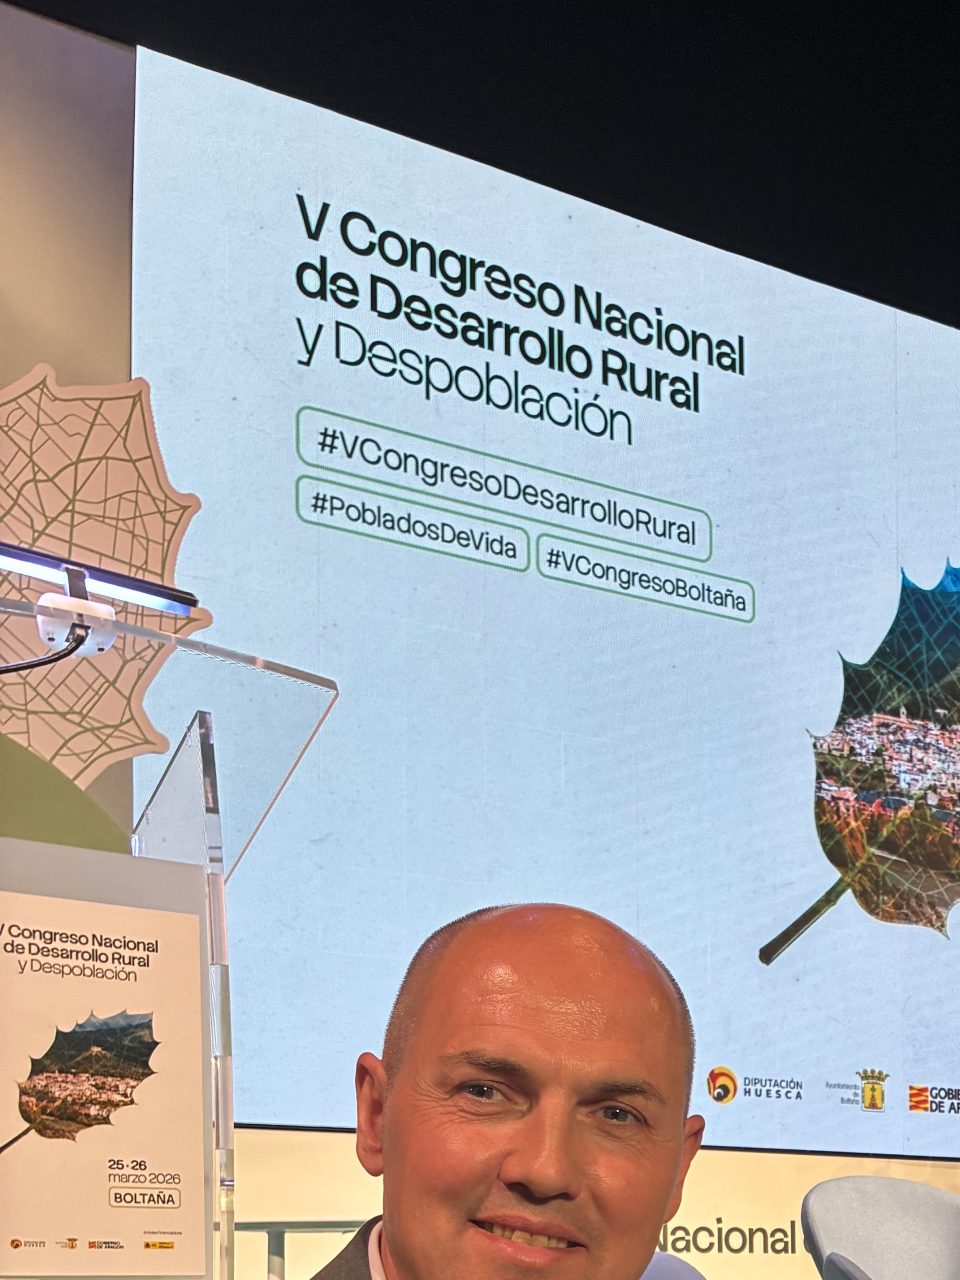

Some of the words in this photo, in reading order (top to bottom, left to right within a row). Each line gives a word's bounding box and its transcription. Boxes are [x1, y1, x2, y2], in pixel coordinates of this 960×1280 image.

[296, 193, 331, 241] V
[340, 209, 565, 318] Congreso
[574, 284, 746, 376] Nacional
[296, 256, 360, 309] de
[371, 273, 593, 379] Desarrollo
[602, 348, 700, 413] Rural
[296, 317, 324, 366] y
[335, 322, 633, 446] Despoblación
[318, 425, 696, 547] #VCongresoDesarrolloRural
[311, 492, 517, 560] #PobladosDeVida
[547, 548, 746, 613] #VCongresoBoltaña
[8, 924, 89, 946] Congreso
[92, 934, 159, 953] Nacional
[3, 940, 26, 955] de
[28, 942, 109, 963] Desarrollo
[111, 951, 150, 968] Rural
[18, 959, 28, 974] y
[30, 958, 138, 982] Despoblación
[743, 1076, 803, 1090] DIPUTACIÓN
[743, 1088, 803, 1100] HUESCA
[929, 1100, 945, 1114] DE
[108, 1159, 125, 1170] 25
[130, 1160, 147, 1171] 26
[108, 1173, 147, 1184] marzo
[148, 1172, 181, 1185] 2026
[114, 1191, 176, 1205] BOLTAÑA
